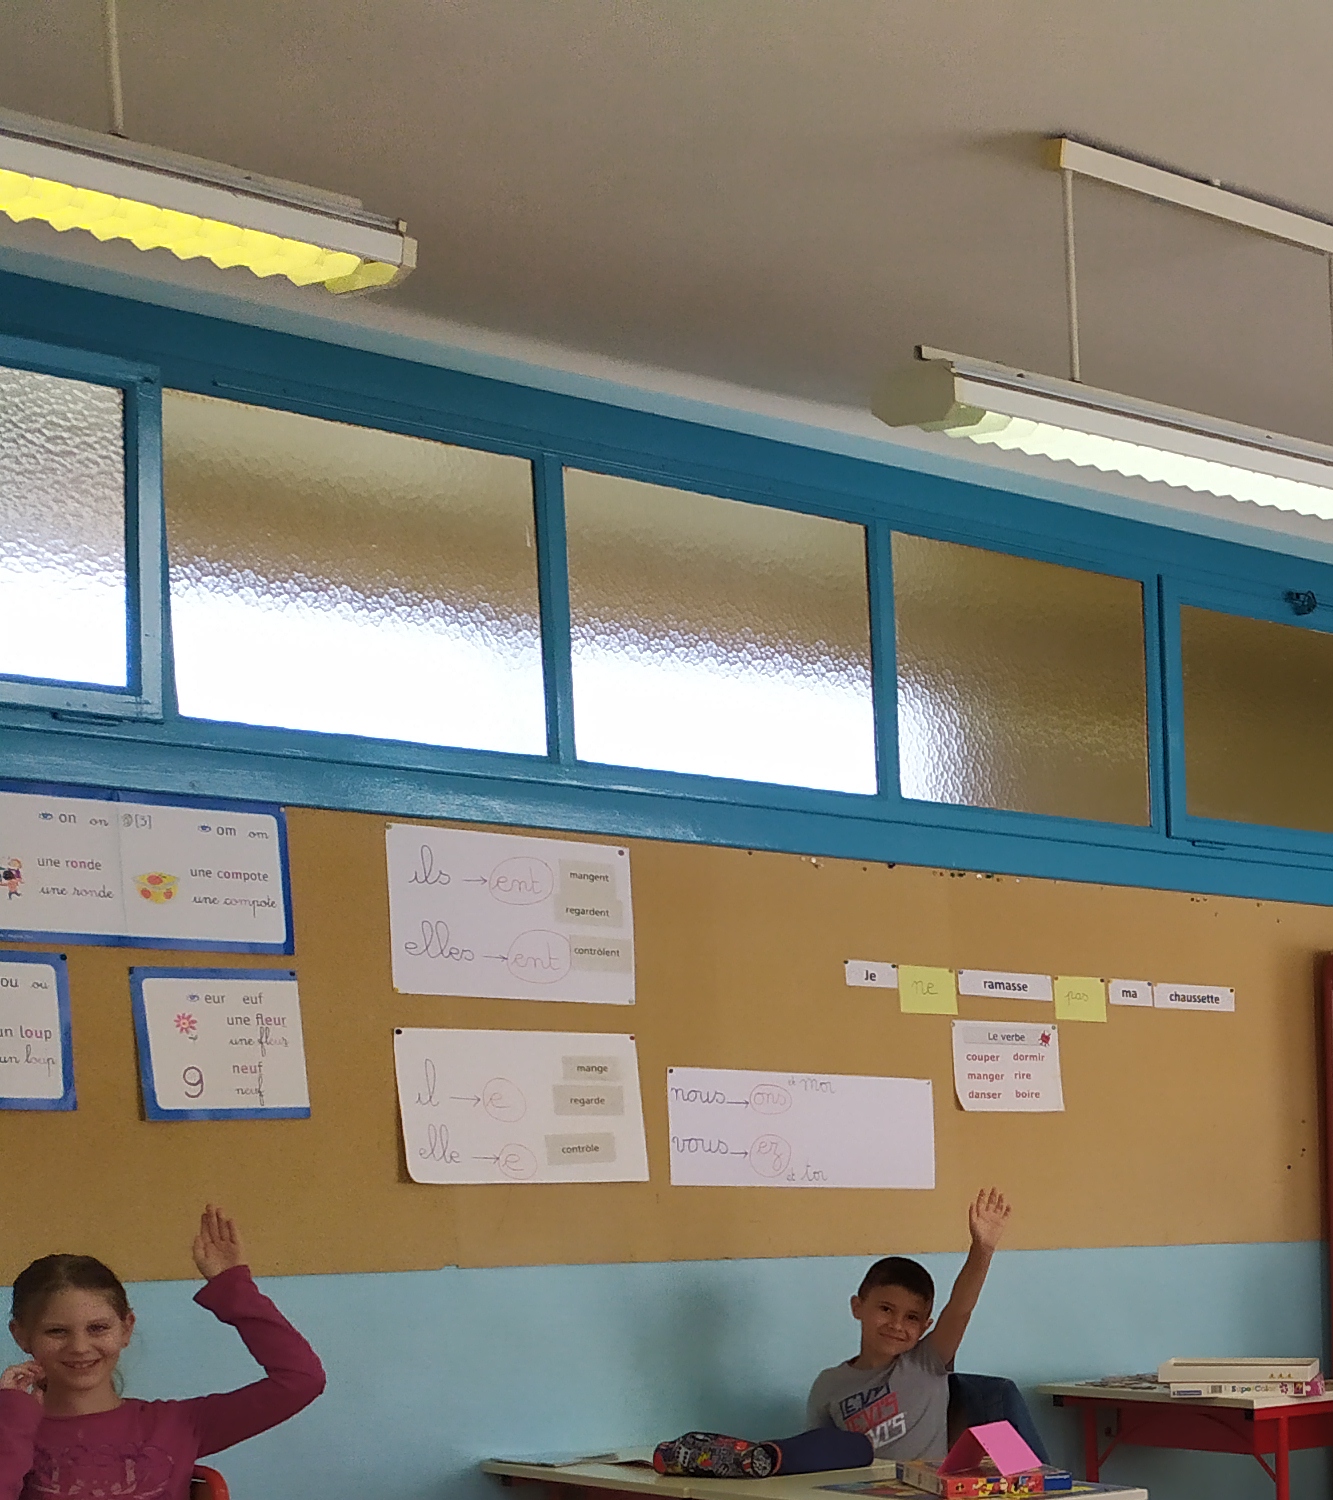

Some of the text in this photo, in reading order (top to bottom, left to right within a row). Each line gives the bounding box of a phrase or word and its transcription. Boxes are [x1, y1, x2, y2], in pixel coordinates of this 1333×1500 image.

[58, 812, 77, 824] on
[216, 825, 237, 837] om
[37, 857, 102, 871] une ronde
[191, 867, 269, 883] une compote
[569, 869, 610, 883] mangent
[39, 885, 114, 900] une ronde
[192, 895, 278, 918] une compote
[565, 905, 610, 919] regardent
[404, 921, 475, 962] elles
[864, 969, 877, 982] Je
[911, 979, 940, 997] ne
[983, 979, 1029, 993] ramasse
[204, 993, 226, 1005] eur
[242, 992, 264, 1005] euf
[1064, 990, 1089, 1007] pas
[1121, 988, 1138, 999] ma
[1169, 990, 1221, 1006] chaussette
[226, 1014, 287, 1027] une fleur
[20, 1025, 52, 1042] loup
[987, 1031, 1026, 1043] Le verbe
[229, 1036, 254, 1046] une
[966, 1052, 1000, 1064] couper
[1012, 1051, 1046, 1063] dormir
[232, 1062, 264, 1075] neuf
[576, 1063, 608, 1076] mange
[182, 1066, 204, 1098] 9
[967, 1071, 1005, 1083] manger
[1014, 1070, 1032, 1081] rire
[671, 1087, 726, 1104] nous
[968, 1088, 1002, 1100] danser
[1015, 1088, 1040, 1100] boire
[569, 1095, 606, 1108] regarde
[672, 1135, 729, 1154] vous
